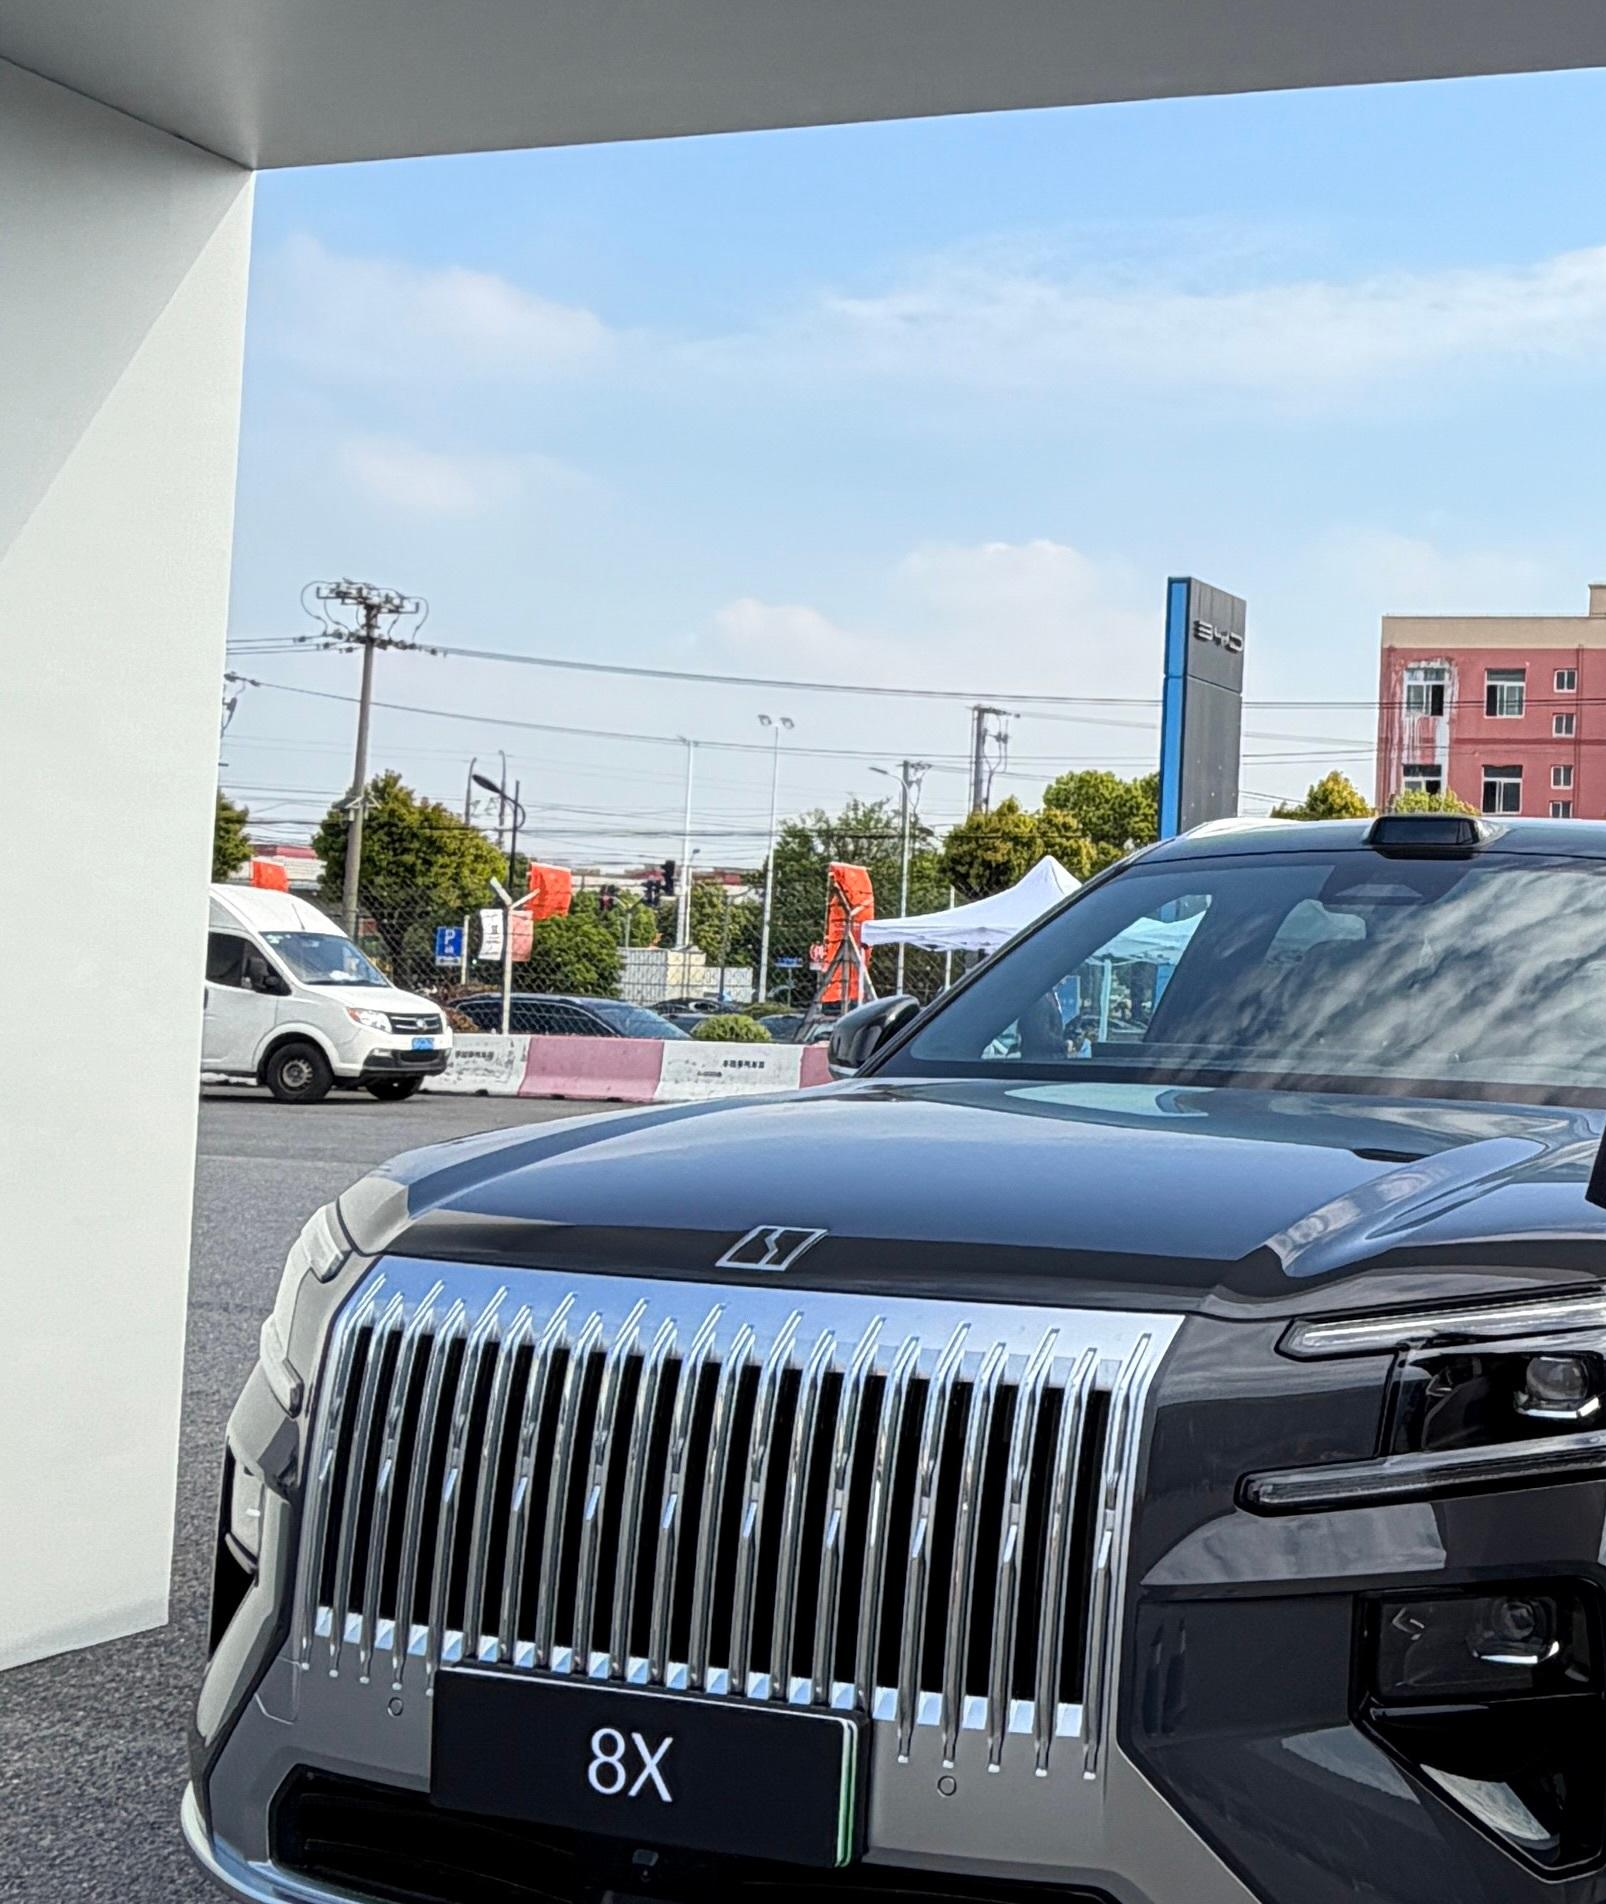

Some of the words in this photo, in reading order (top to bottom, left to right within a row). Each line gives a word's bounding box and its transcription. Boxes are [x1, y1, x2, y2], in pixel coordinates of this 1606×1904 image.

[1193, 620, 1244, 653] BYD
[444, 929, 456, 945] P
[587, 1727, 674, 1803] 8X
